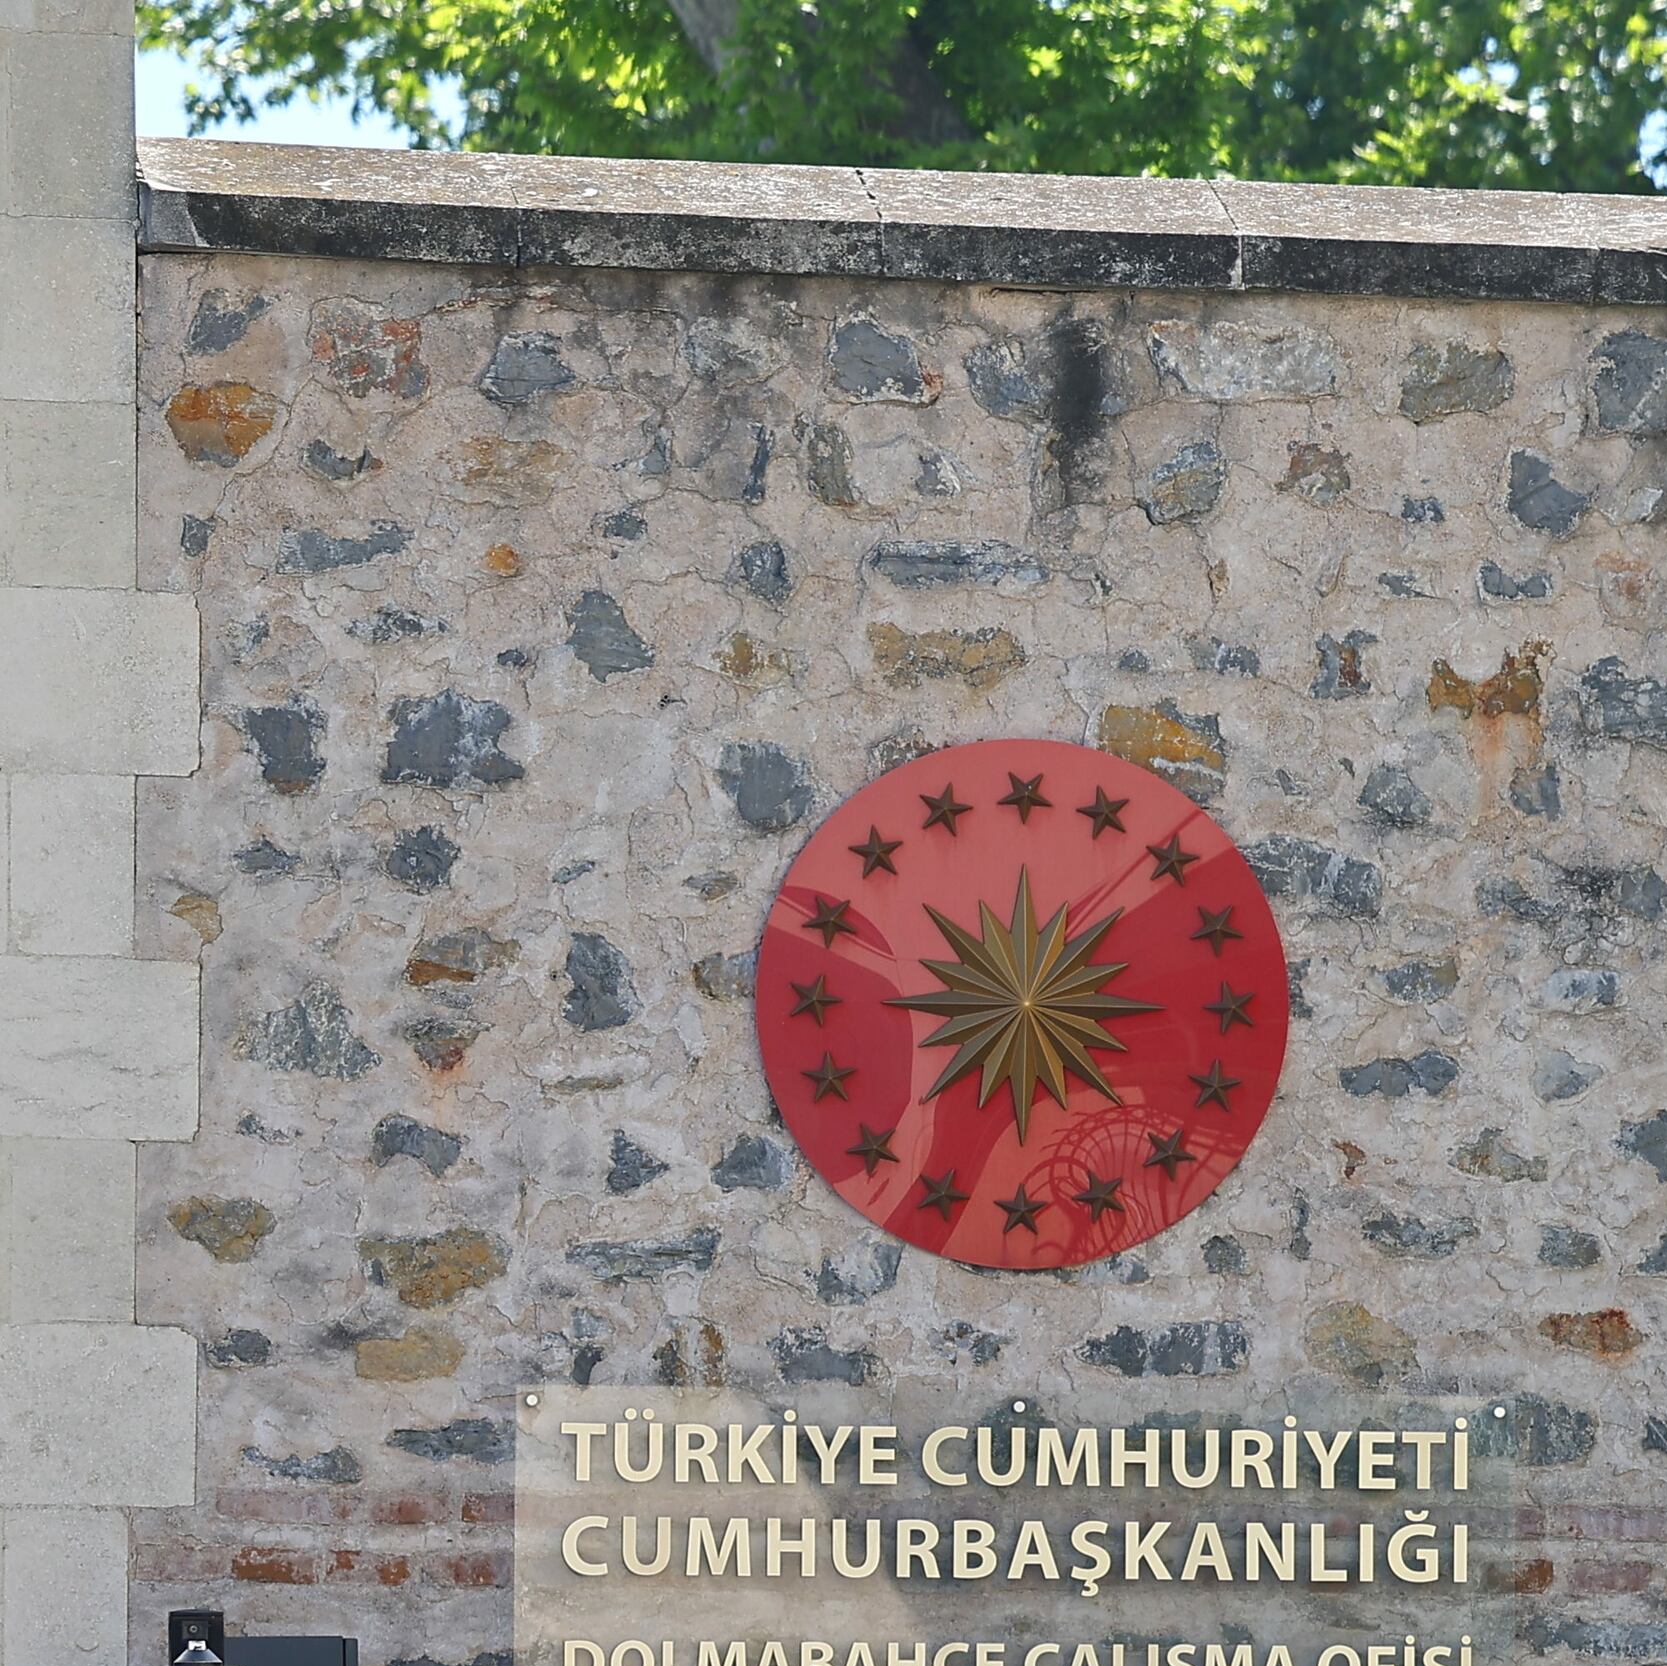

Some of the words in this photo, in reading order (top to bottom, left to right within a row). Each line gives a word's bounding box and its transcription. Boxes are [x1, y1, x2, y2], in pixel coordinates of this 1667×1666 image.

[562, 1409, 898, 1484] TÜRKİYE
[922, 1415, 1470, 1491] CUMHURİYETİ
[561, 1511, 1470, 1596] CUMHURBAŞKANLIĞI
